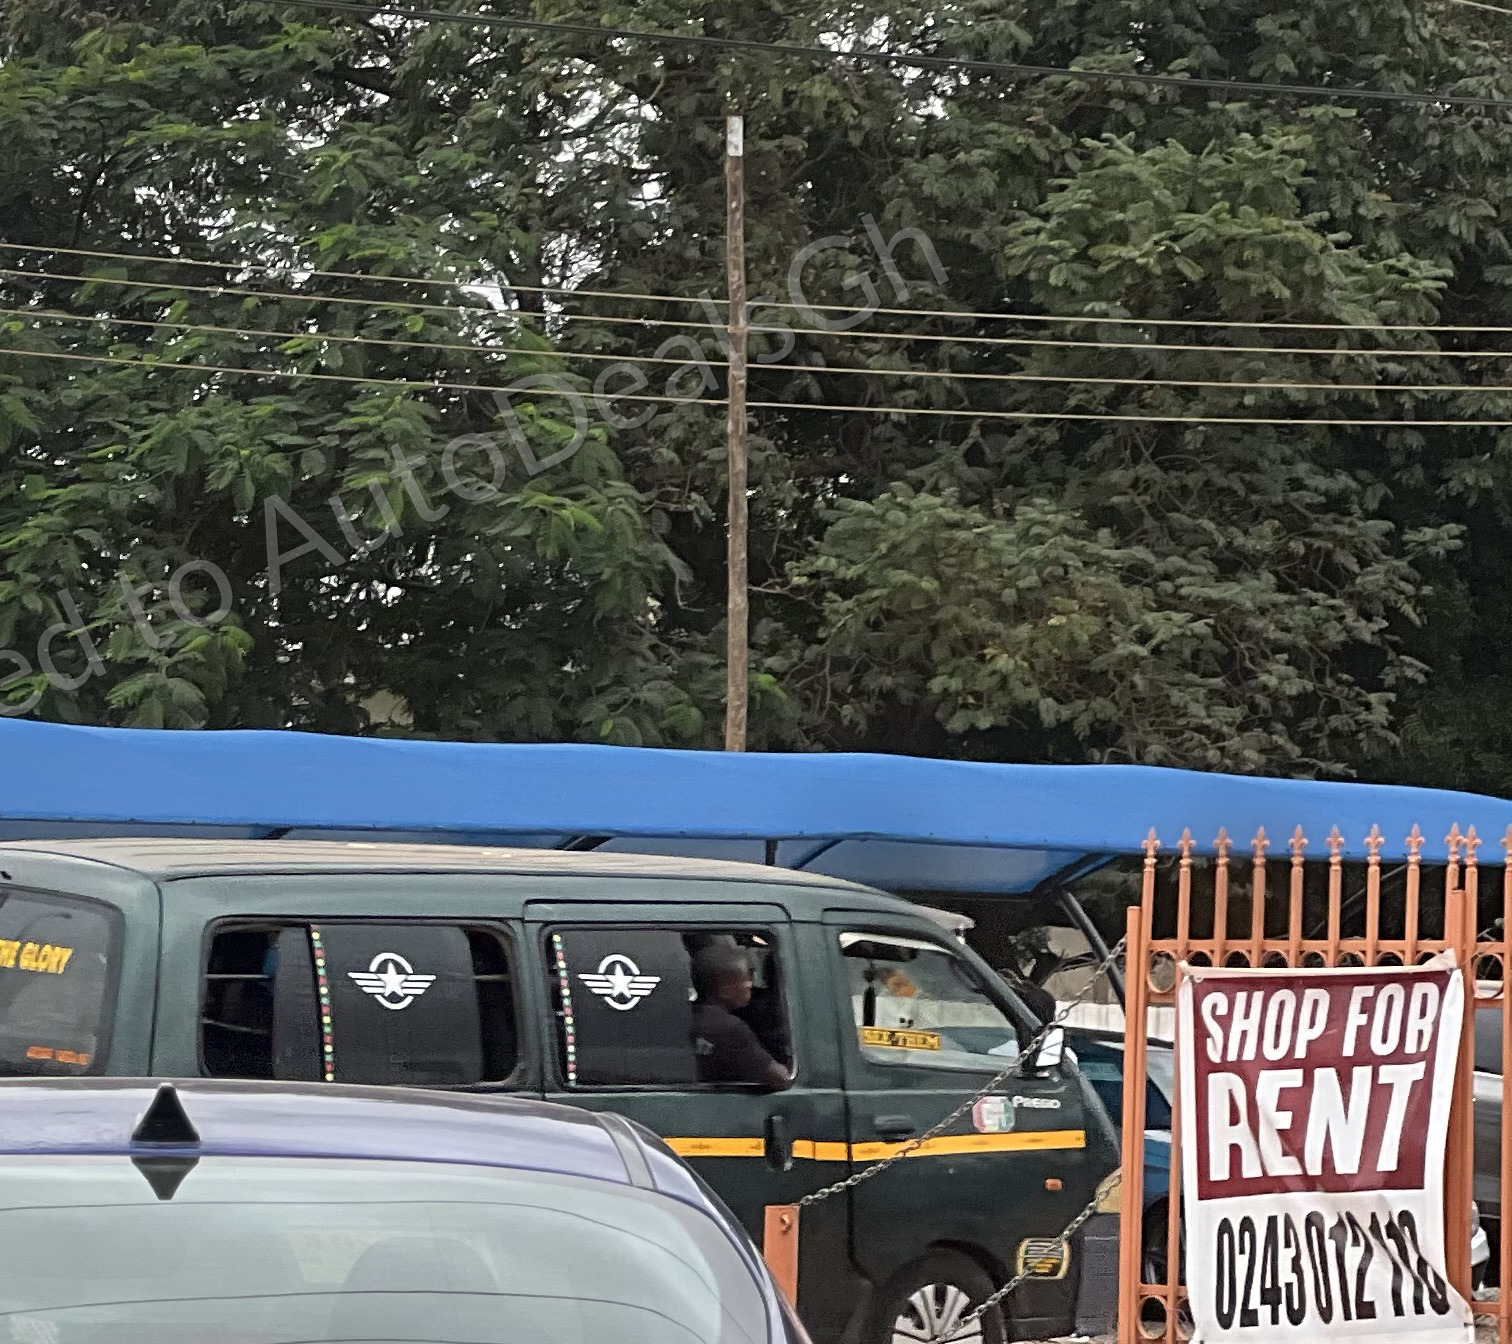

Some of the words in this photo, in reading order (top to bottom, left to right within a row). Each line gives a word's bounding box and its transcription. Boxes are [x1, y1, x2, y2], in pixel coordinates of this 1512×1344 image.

[1201, 988, 1330, 1063] SHOP
[1342, 982, 1440, 1057] FOR
[1208, 1061, 1426, 1181] RENT
